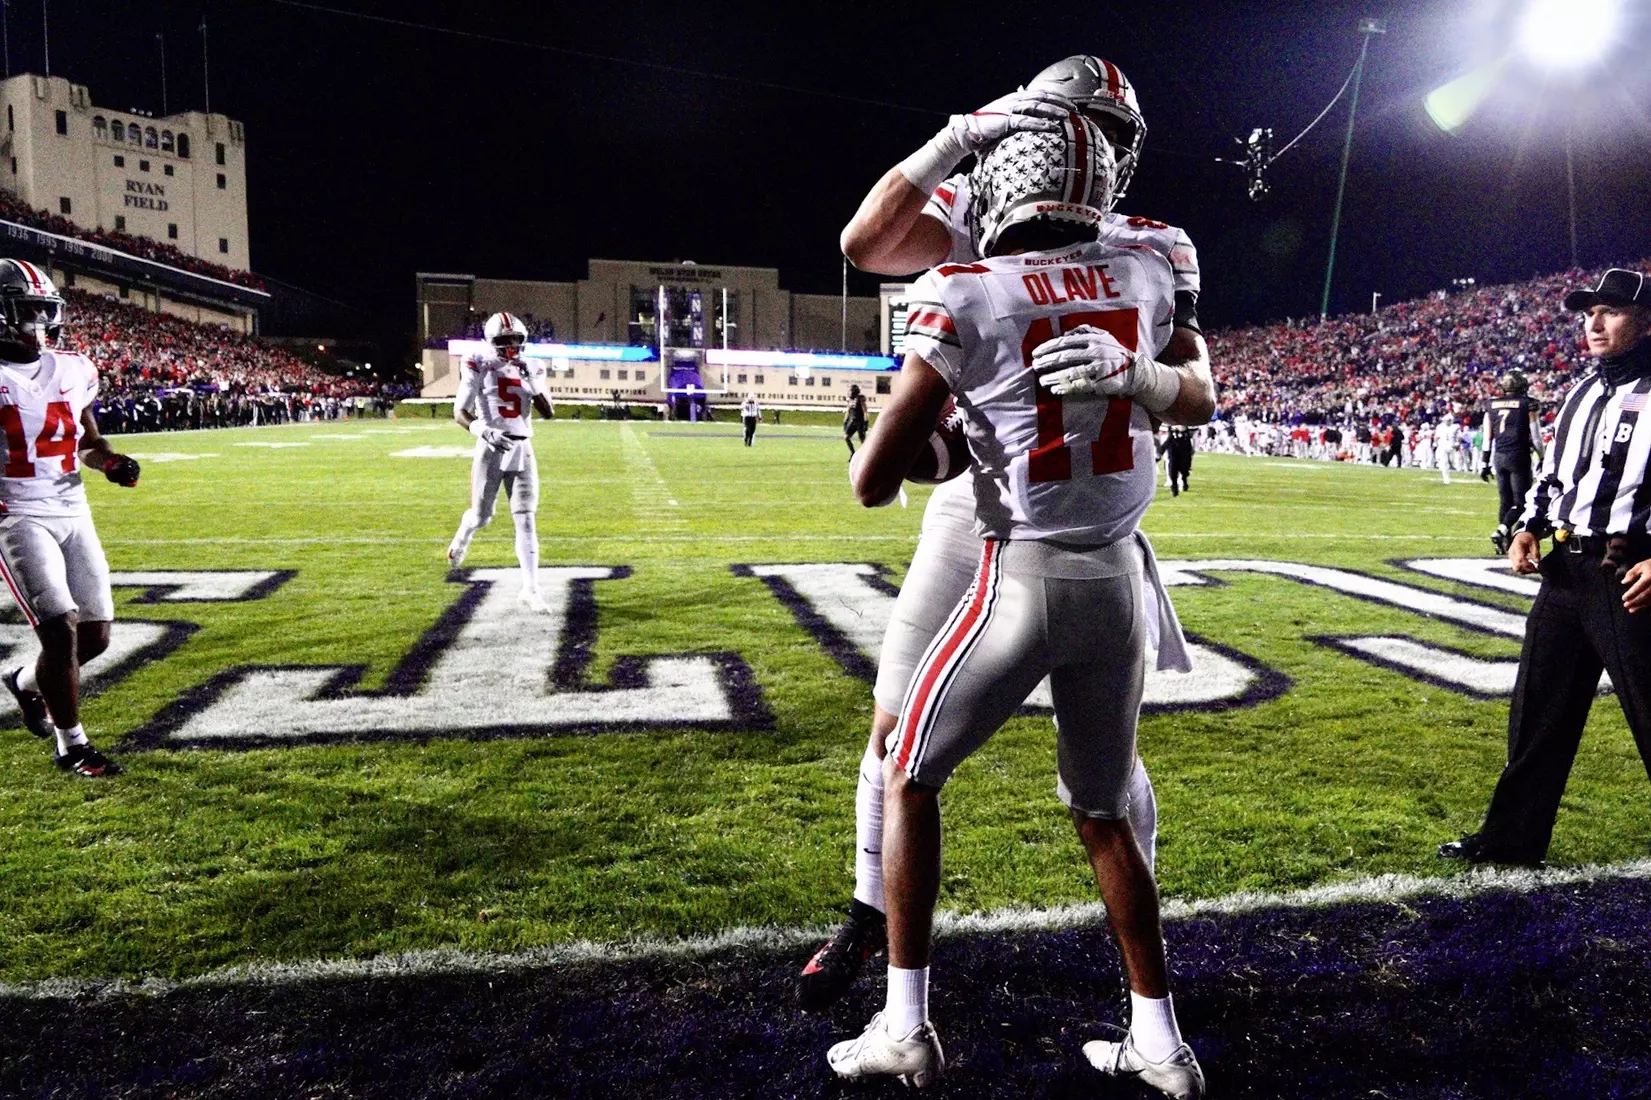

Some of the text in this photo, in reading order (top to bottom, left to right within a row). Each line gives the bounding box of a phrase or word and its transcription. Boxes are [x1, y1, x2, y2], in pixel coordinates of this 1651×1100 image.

[125, 179, 165, 197] RYAN
[124, 194, 169, 211] FIELD
[1036, 203, 1102, 222] BUCKEYES
[1024, 250, 1083, 266] BUCKEYES
[1022, 264, 1121, 306] OLAVE
[497, 376, 522, 419] 5
[1021, 308, 1139, 484] 17
[1497, 409, 1511, 434] 7
[1613, 422, 1634, 443] B
[0, 401, 77, 478] 14
